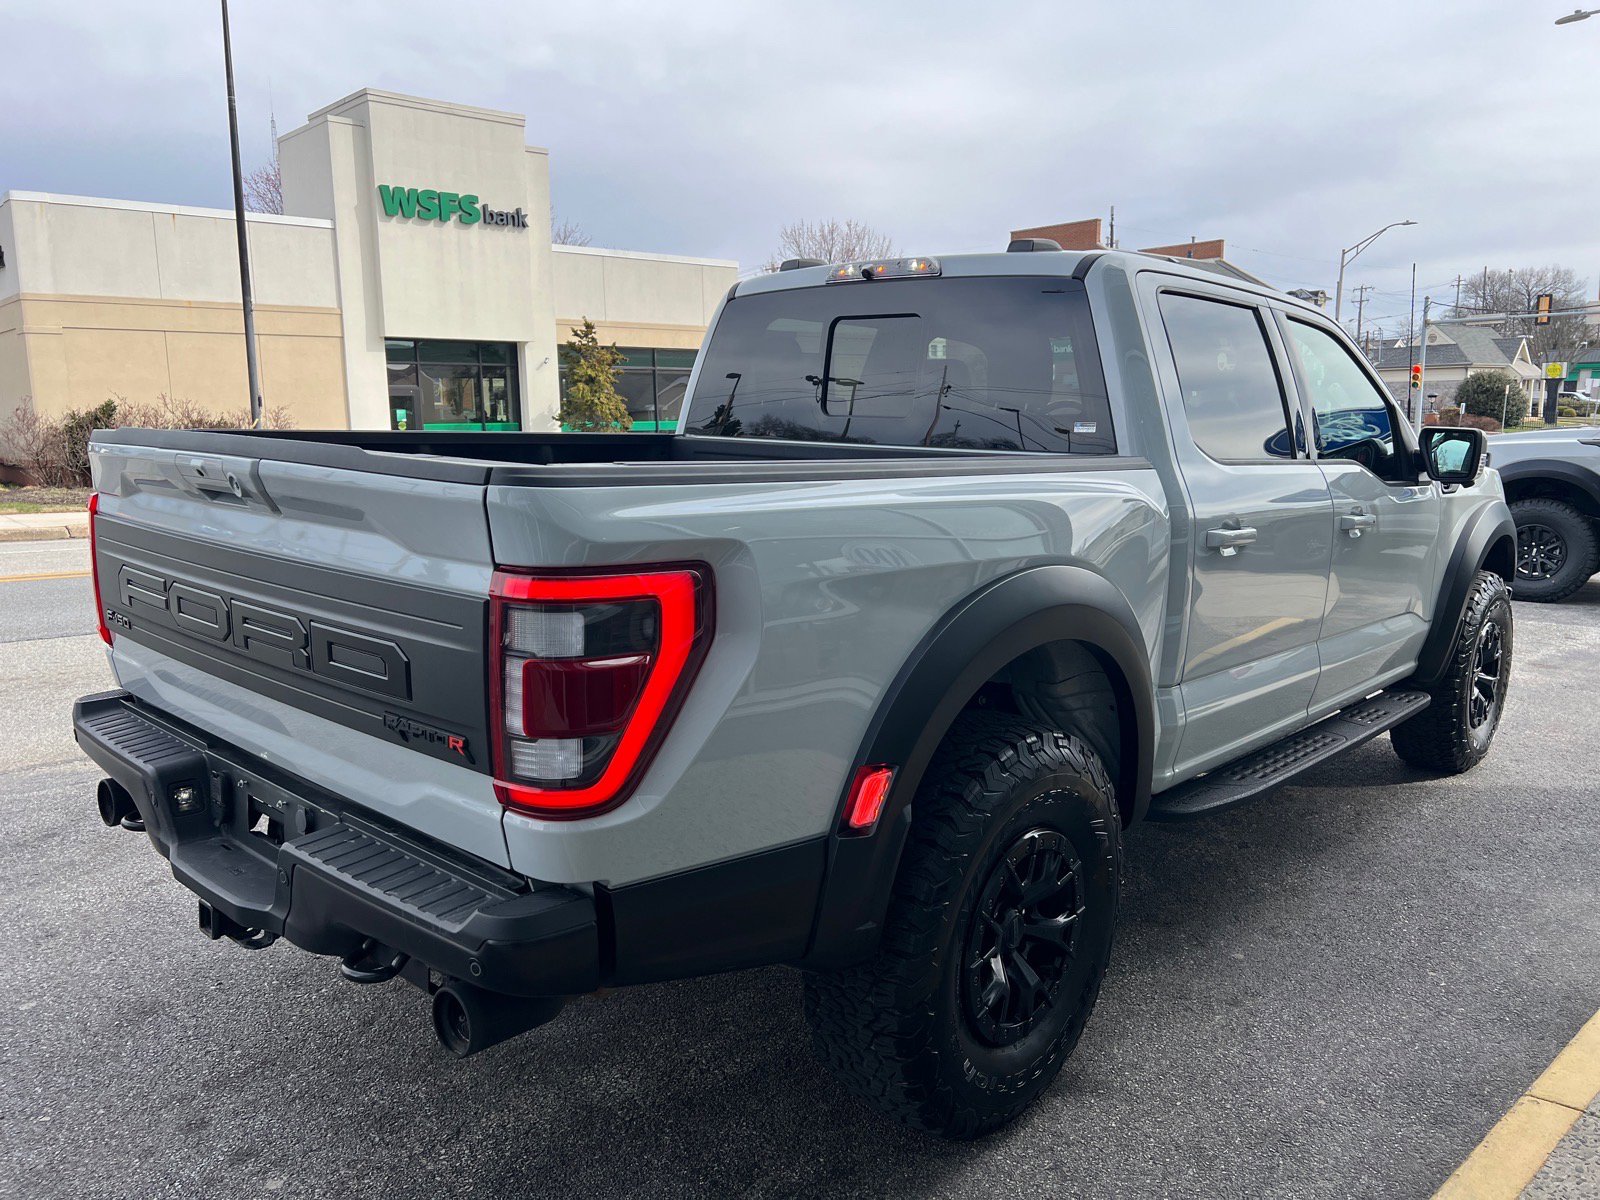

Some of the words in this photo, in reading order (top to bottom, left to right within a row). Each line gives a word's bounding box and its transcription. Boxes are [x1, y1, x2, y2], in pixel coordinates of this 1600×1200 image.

[378, 184, 482, 225] WSFS
[482, 203, 529, 228] bank
[117, 563, 414, 702] FORD
